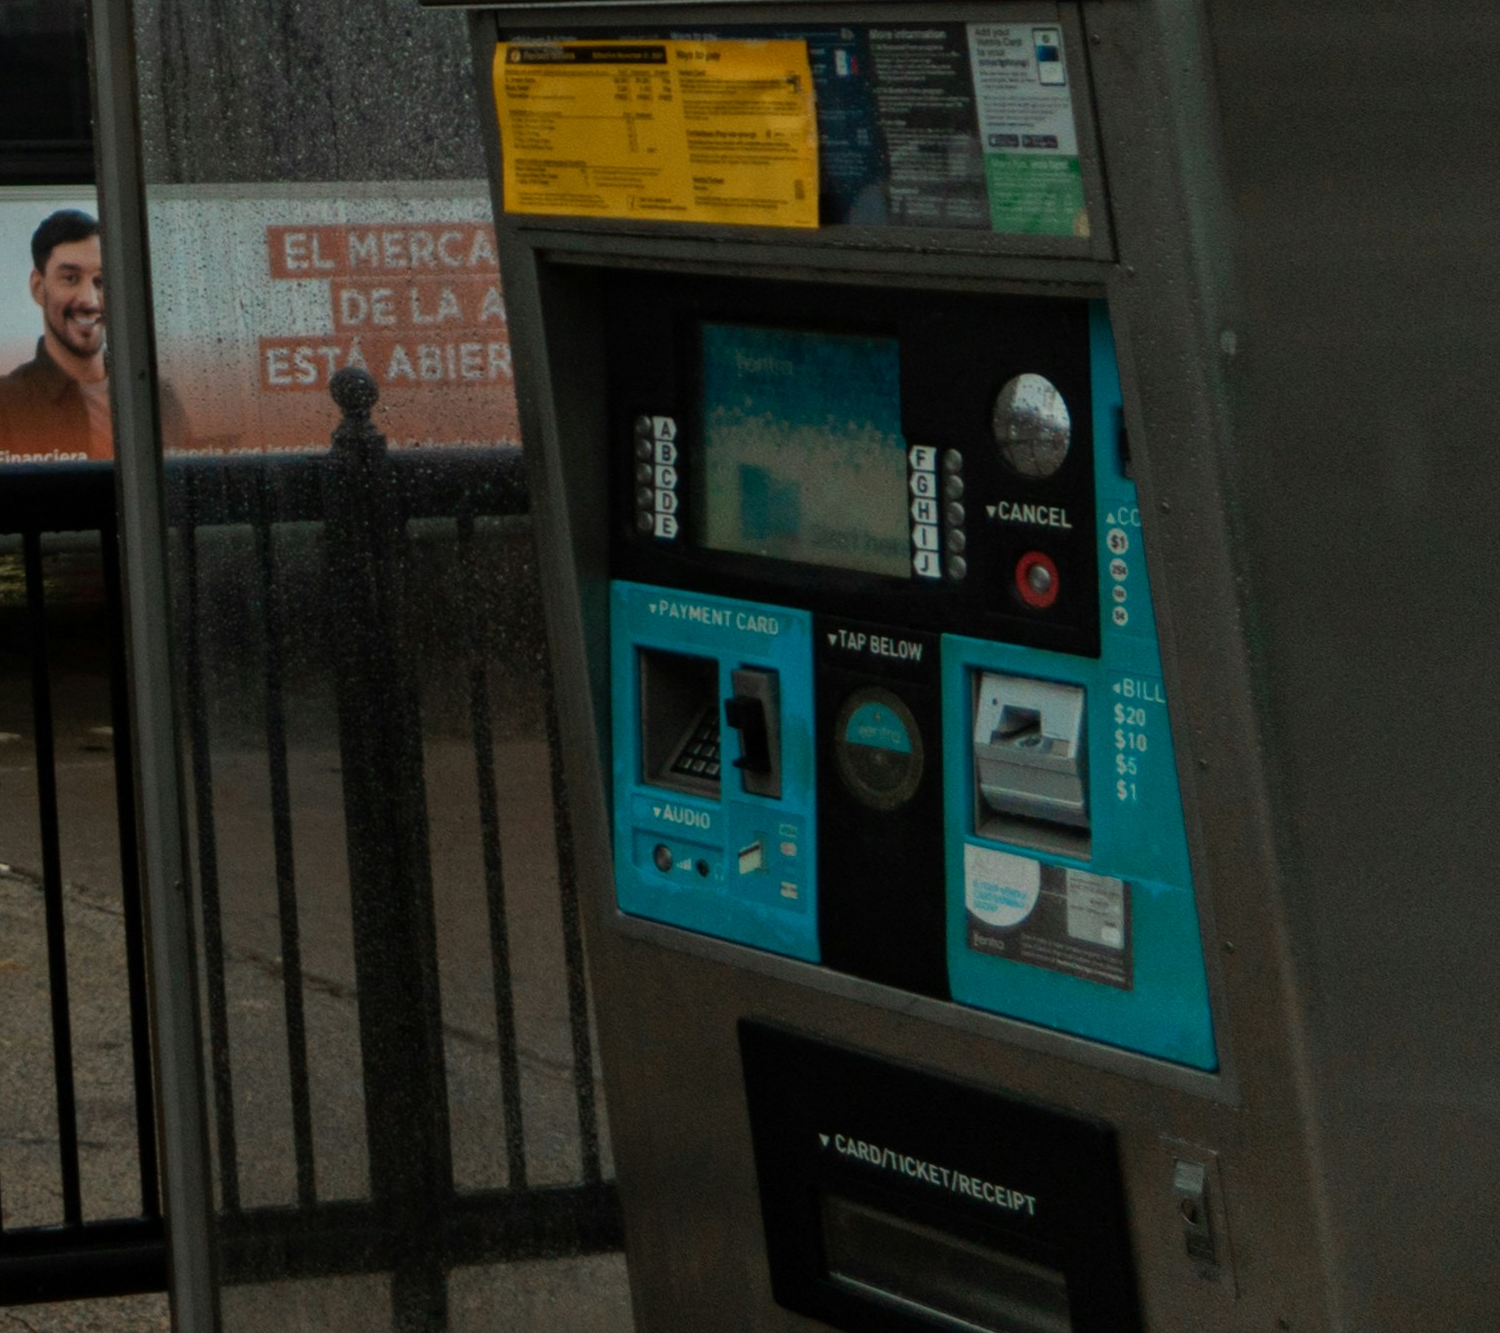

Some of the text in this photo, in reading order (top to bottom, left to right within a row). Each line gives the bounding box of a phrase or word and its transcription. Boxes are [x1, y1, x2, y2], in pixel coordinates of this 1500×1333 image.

[283, 229, 497, 271] EL MERCA
[340, 285, 507, 326] DE LA A
[266, 336, 513, 385] ESTÁ ABIER
[660, 421, 672, 438] A
[661, 444, 671, 462] B
[916, 449, 926, 467] F
[662, 469, 672, 485] C
[917, 475, 928, 493] G
[662, 493, 672, 510] D
[918, 502, 929, 520] H
[662, 518, 672, 534] E
[998, 500, 1073, 529] CANCEL
[920, 555, 929, 572] J
[658, 599, 779, 636] PAYMENT CARD
[838, 629, 923, 661] TAP BELOW
[1113, 702, 1146, 727] $20
[1114, 728, 1148, 752] $10
[1115, 752, 1137, 775] $5
[1116, 778, 1137, 801] $1
[662, 803, 711, 830] AUDIO
[834, 1133, 1037, 1217] CARD/TICKET/RECEIPT
